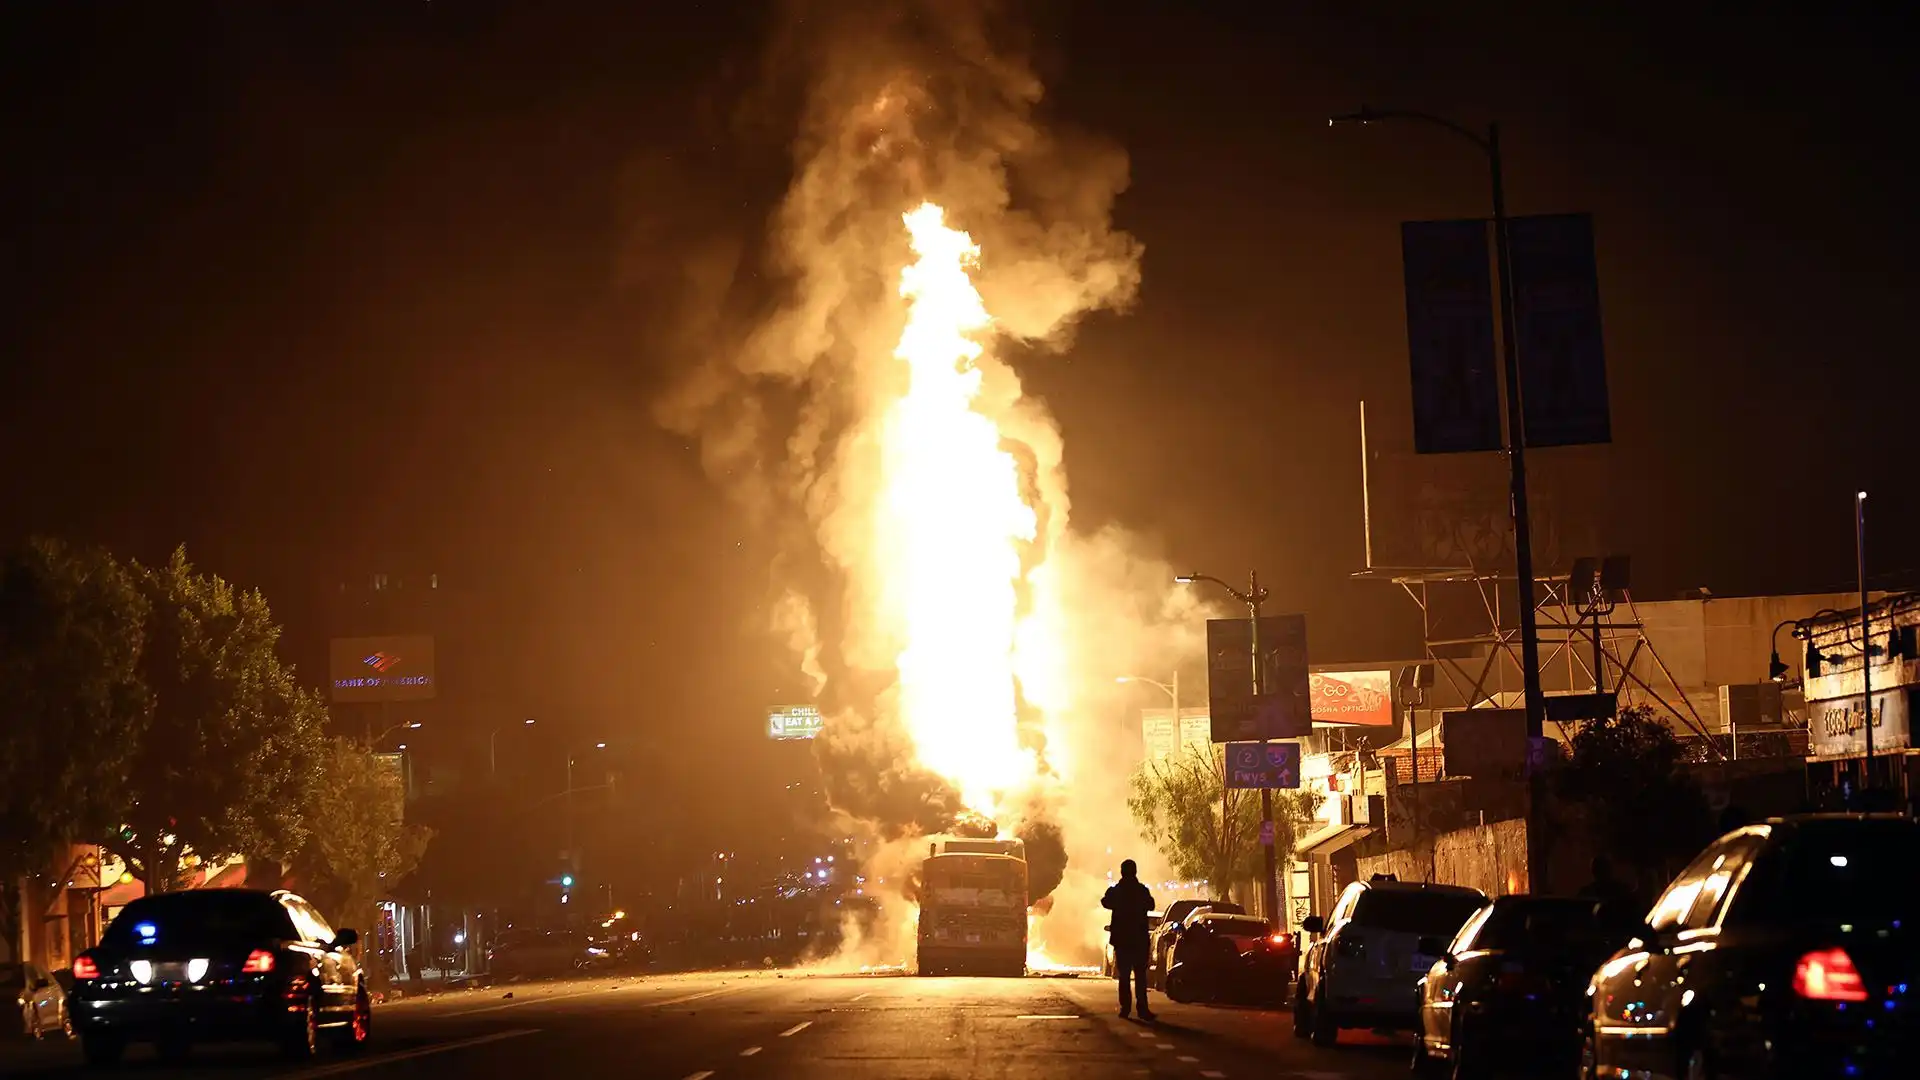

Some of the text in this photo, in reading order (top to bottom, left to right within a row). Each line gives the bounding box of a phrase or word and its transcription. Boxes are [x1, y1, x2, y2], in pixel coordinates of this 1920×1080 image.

[785, 717, 803, 726] EAT
[1244, 752, 1283, 763] 2 5
[1234, 770, 1267, 785] Fwys
